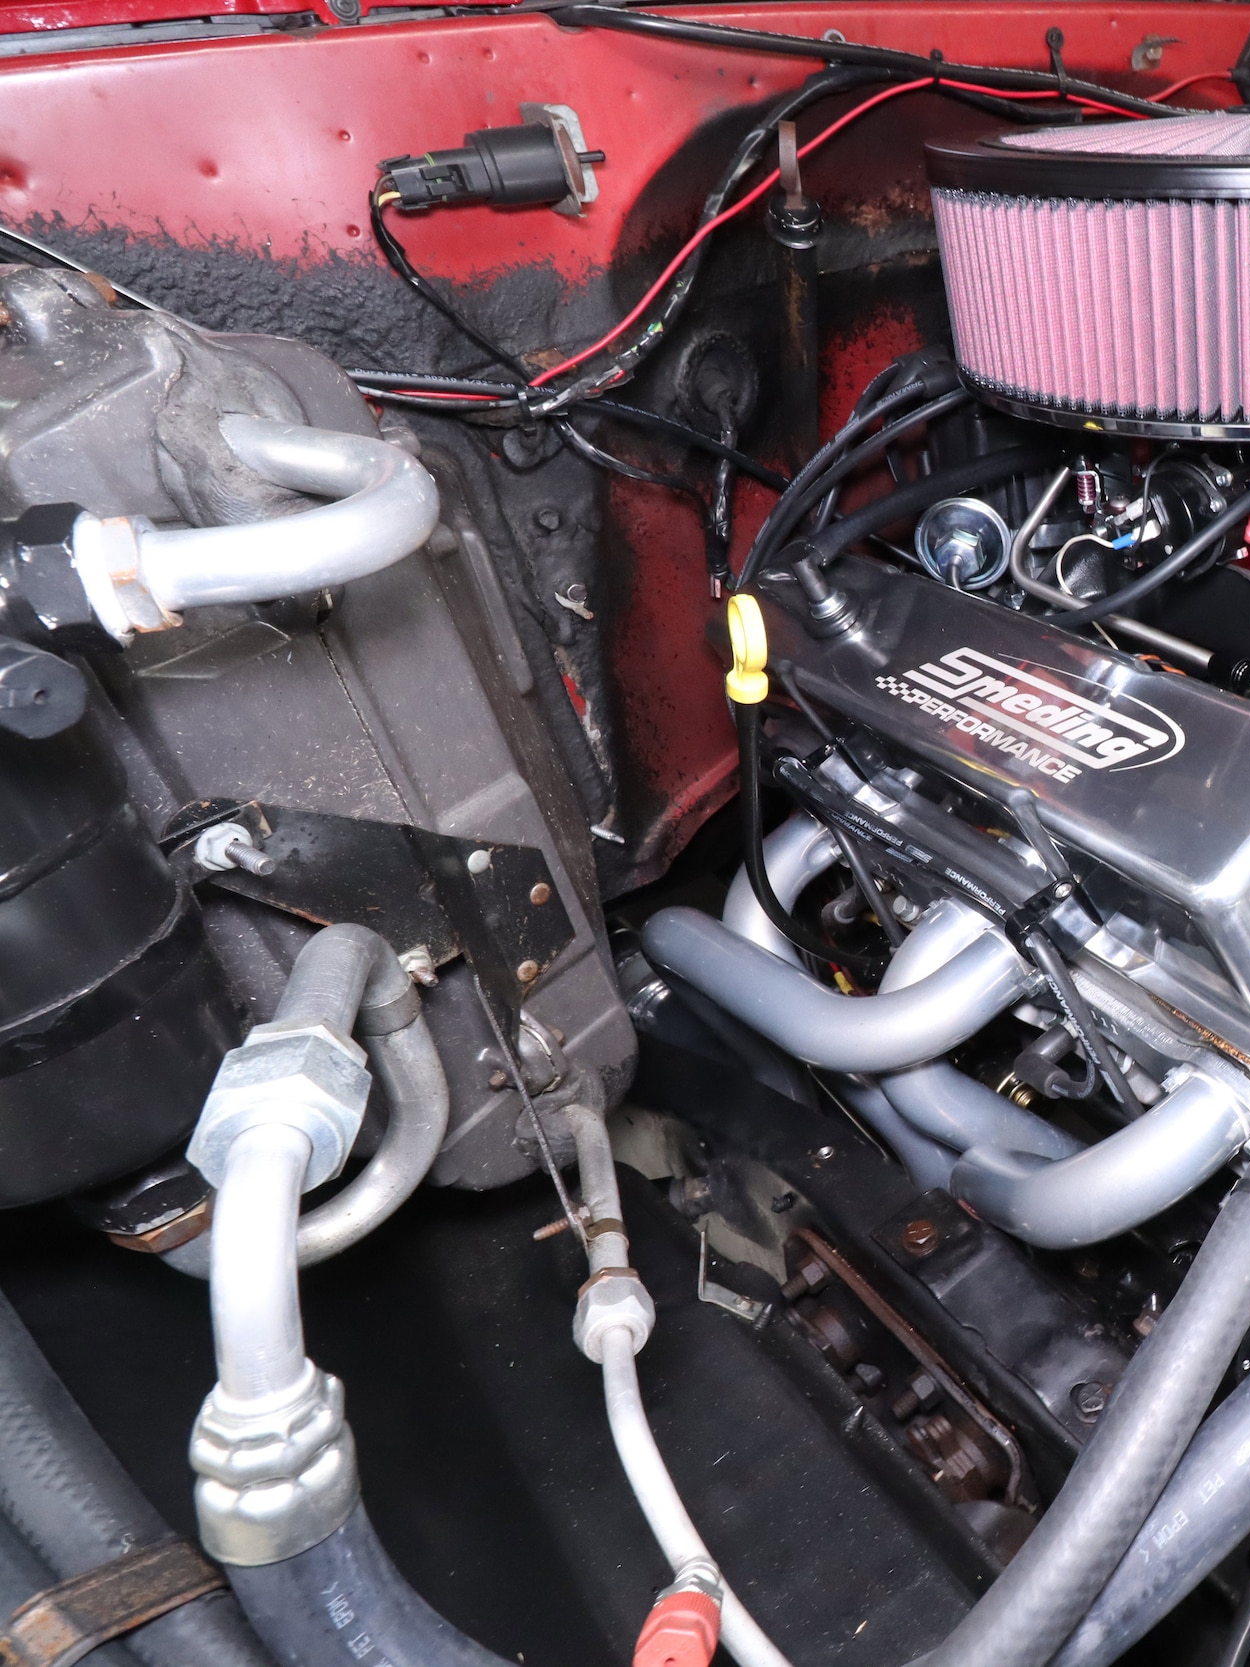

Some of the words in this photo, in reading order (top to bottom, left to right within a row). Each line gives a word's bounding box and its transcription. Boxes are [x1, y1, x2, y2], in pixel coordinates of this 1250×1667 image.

[902, 646, 1170, 770] Smeding
[913, 688, 1083, 784] PERFORMANCE
[944, 867, 1007, 916] PERFORMANCE
[1200, 1472, 1226, 1505] PET
[1152, 1510, 1190, 1550] EPDM
[325, 1593, 356, 1631] EPDM
[347, 1631, 376, 1660] PET
